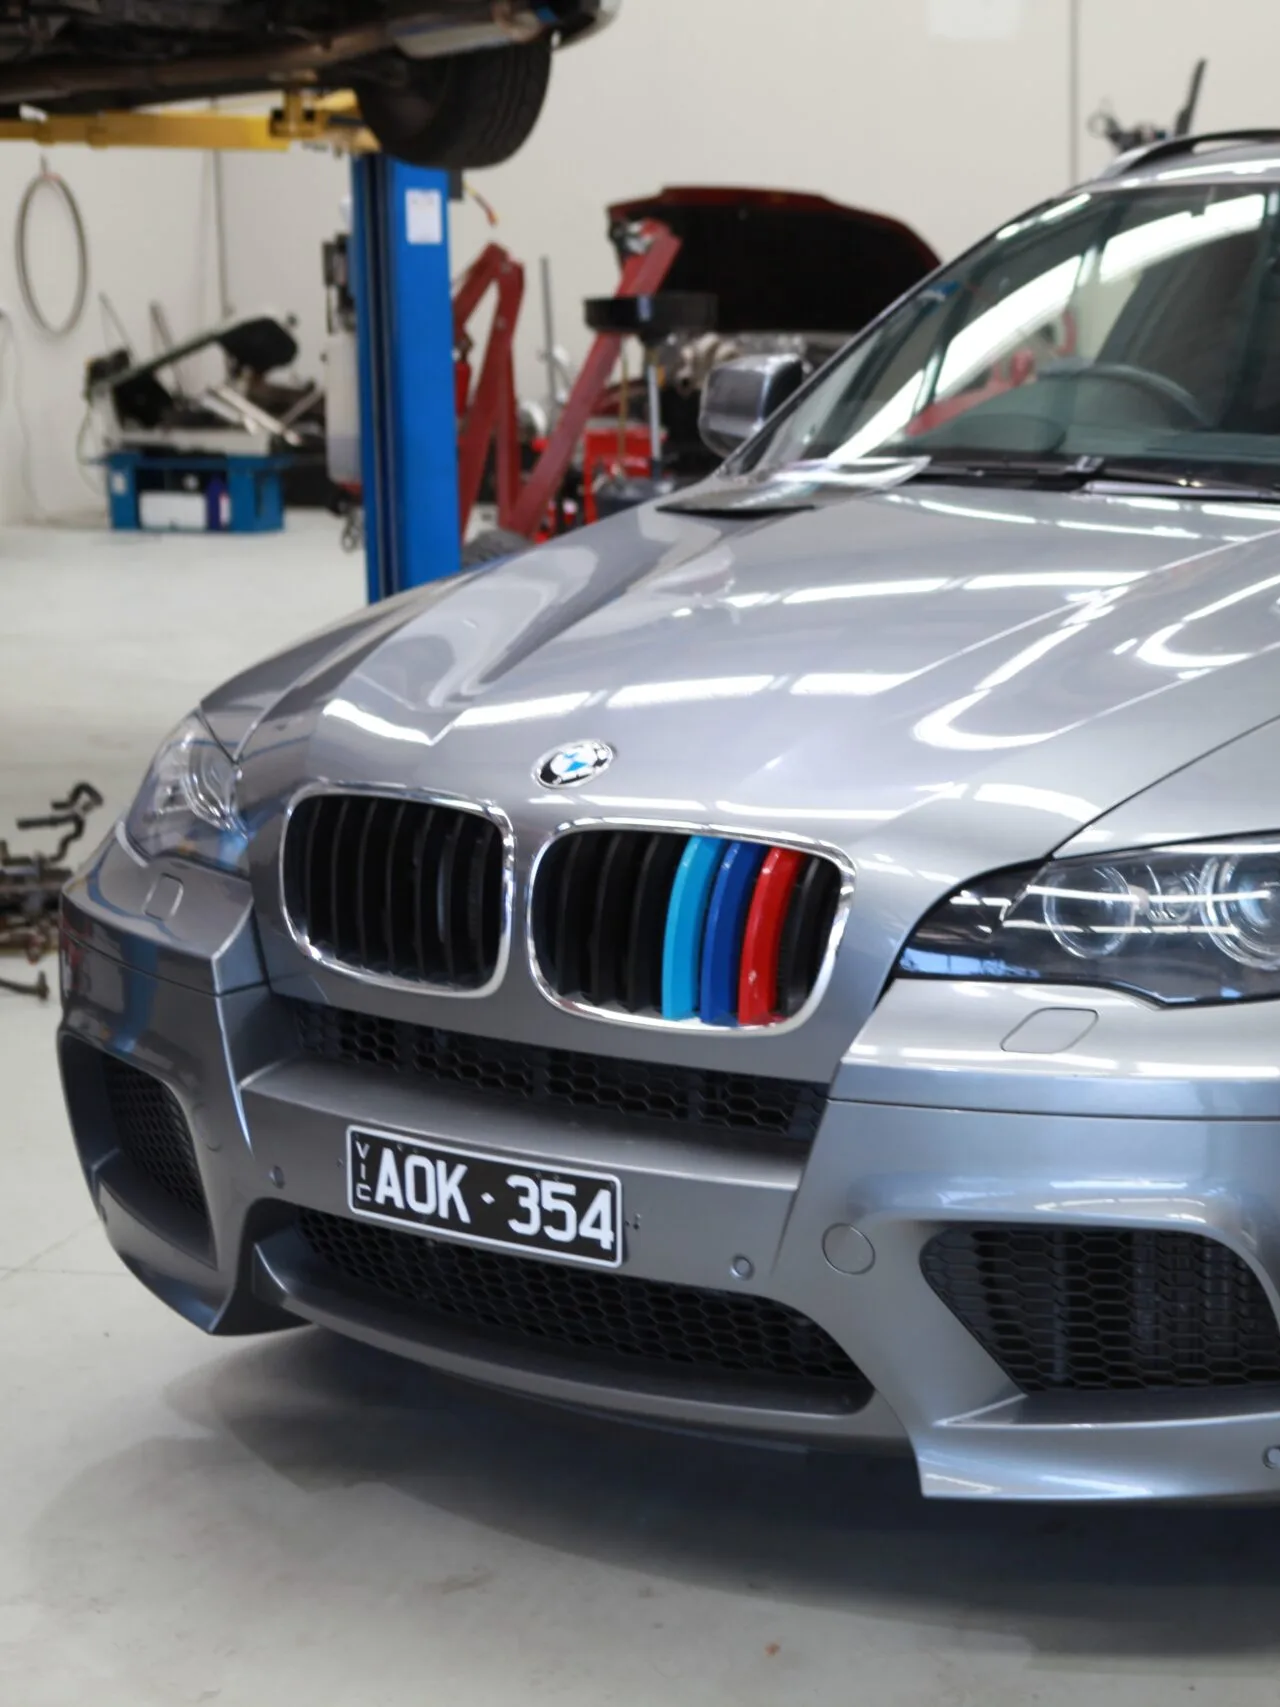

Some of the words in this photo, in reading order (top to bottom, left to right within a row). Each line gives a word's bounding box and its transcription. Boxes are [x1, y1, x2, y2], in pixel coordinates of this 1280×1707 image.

[355, 1140, 372, 1202] VIC
[374, 1147, 472, 1224] AOK
[505, 1174, 615, 1251] 354
